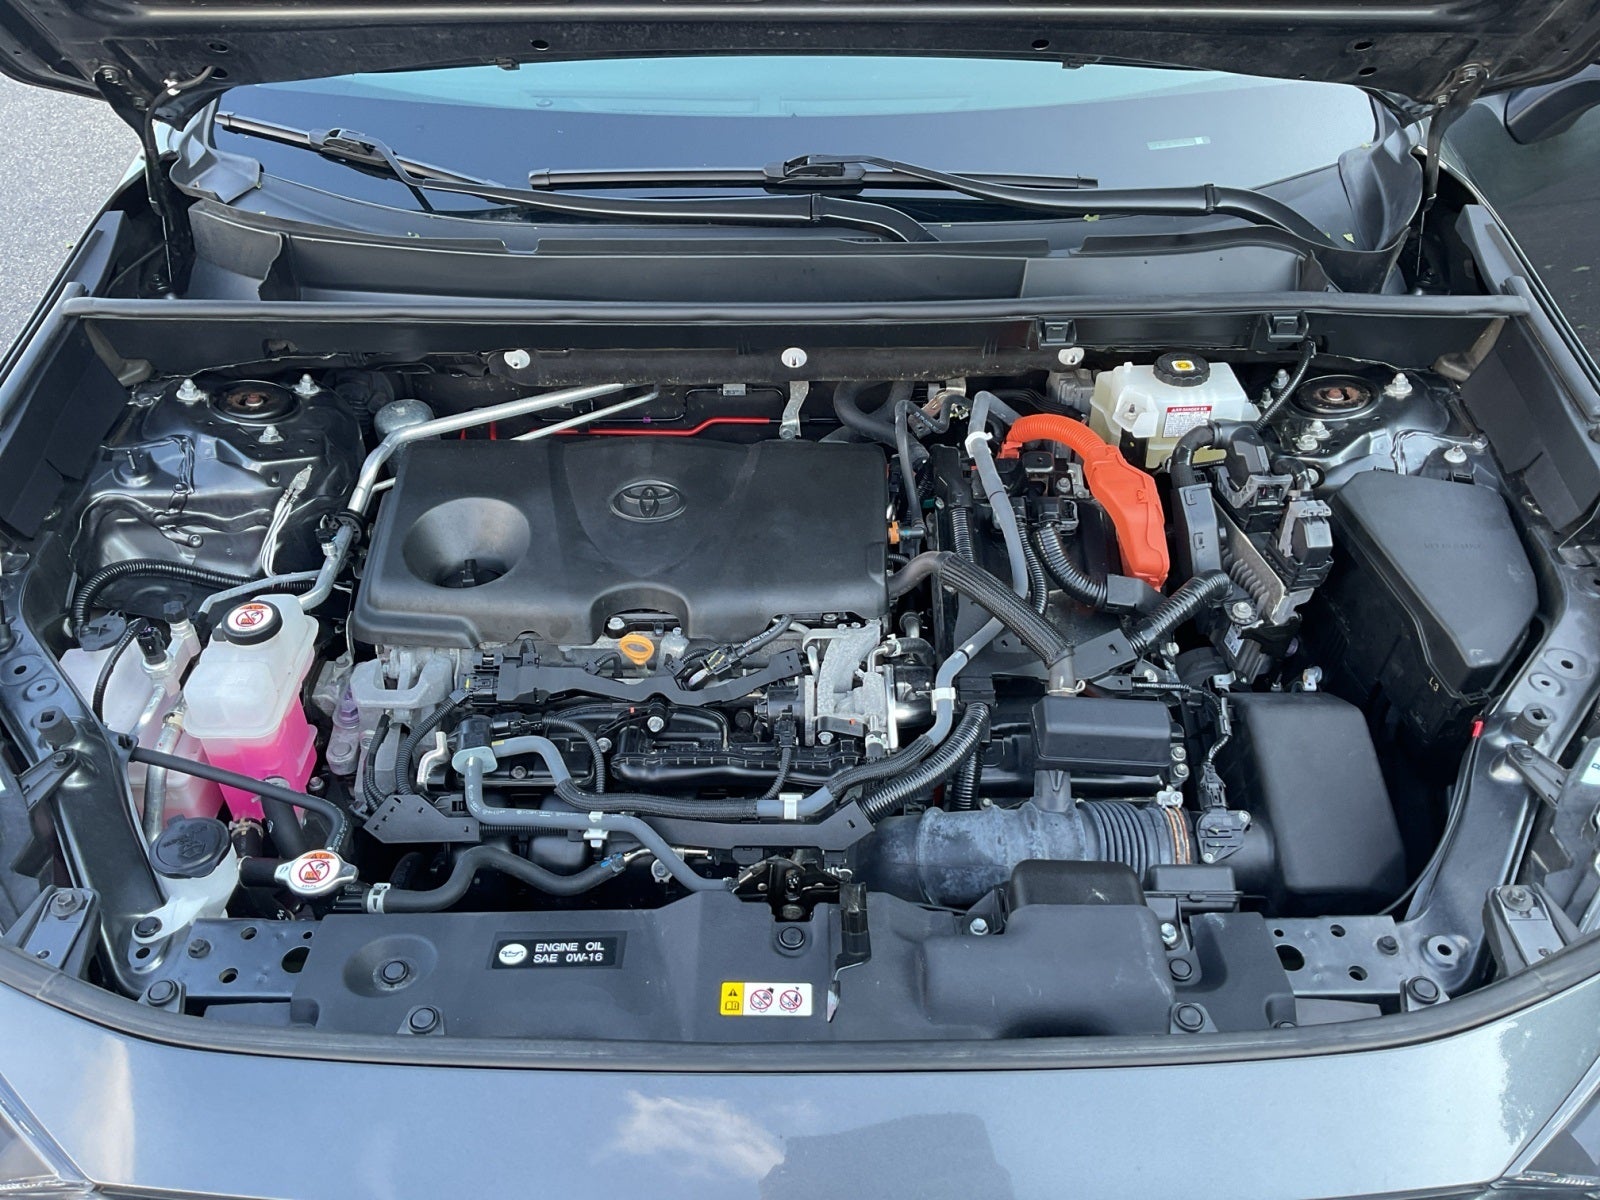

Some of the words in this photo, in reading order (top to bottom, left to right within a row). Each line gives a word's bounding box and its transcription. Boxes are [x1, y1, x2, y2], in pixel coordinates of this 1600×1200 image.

[534, 942, 578, 953] ENGINE
[585, 941, 605, 952] OIL
[533, 953, 558, 963] SAE
[565, 952, 603, 963] 0W-16
